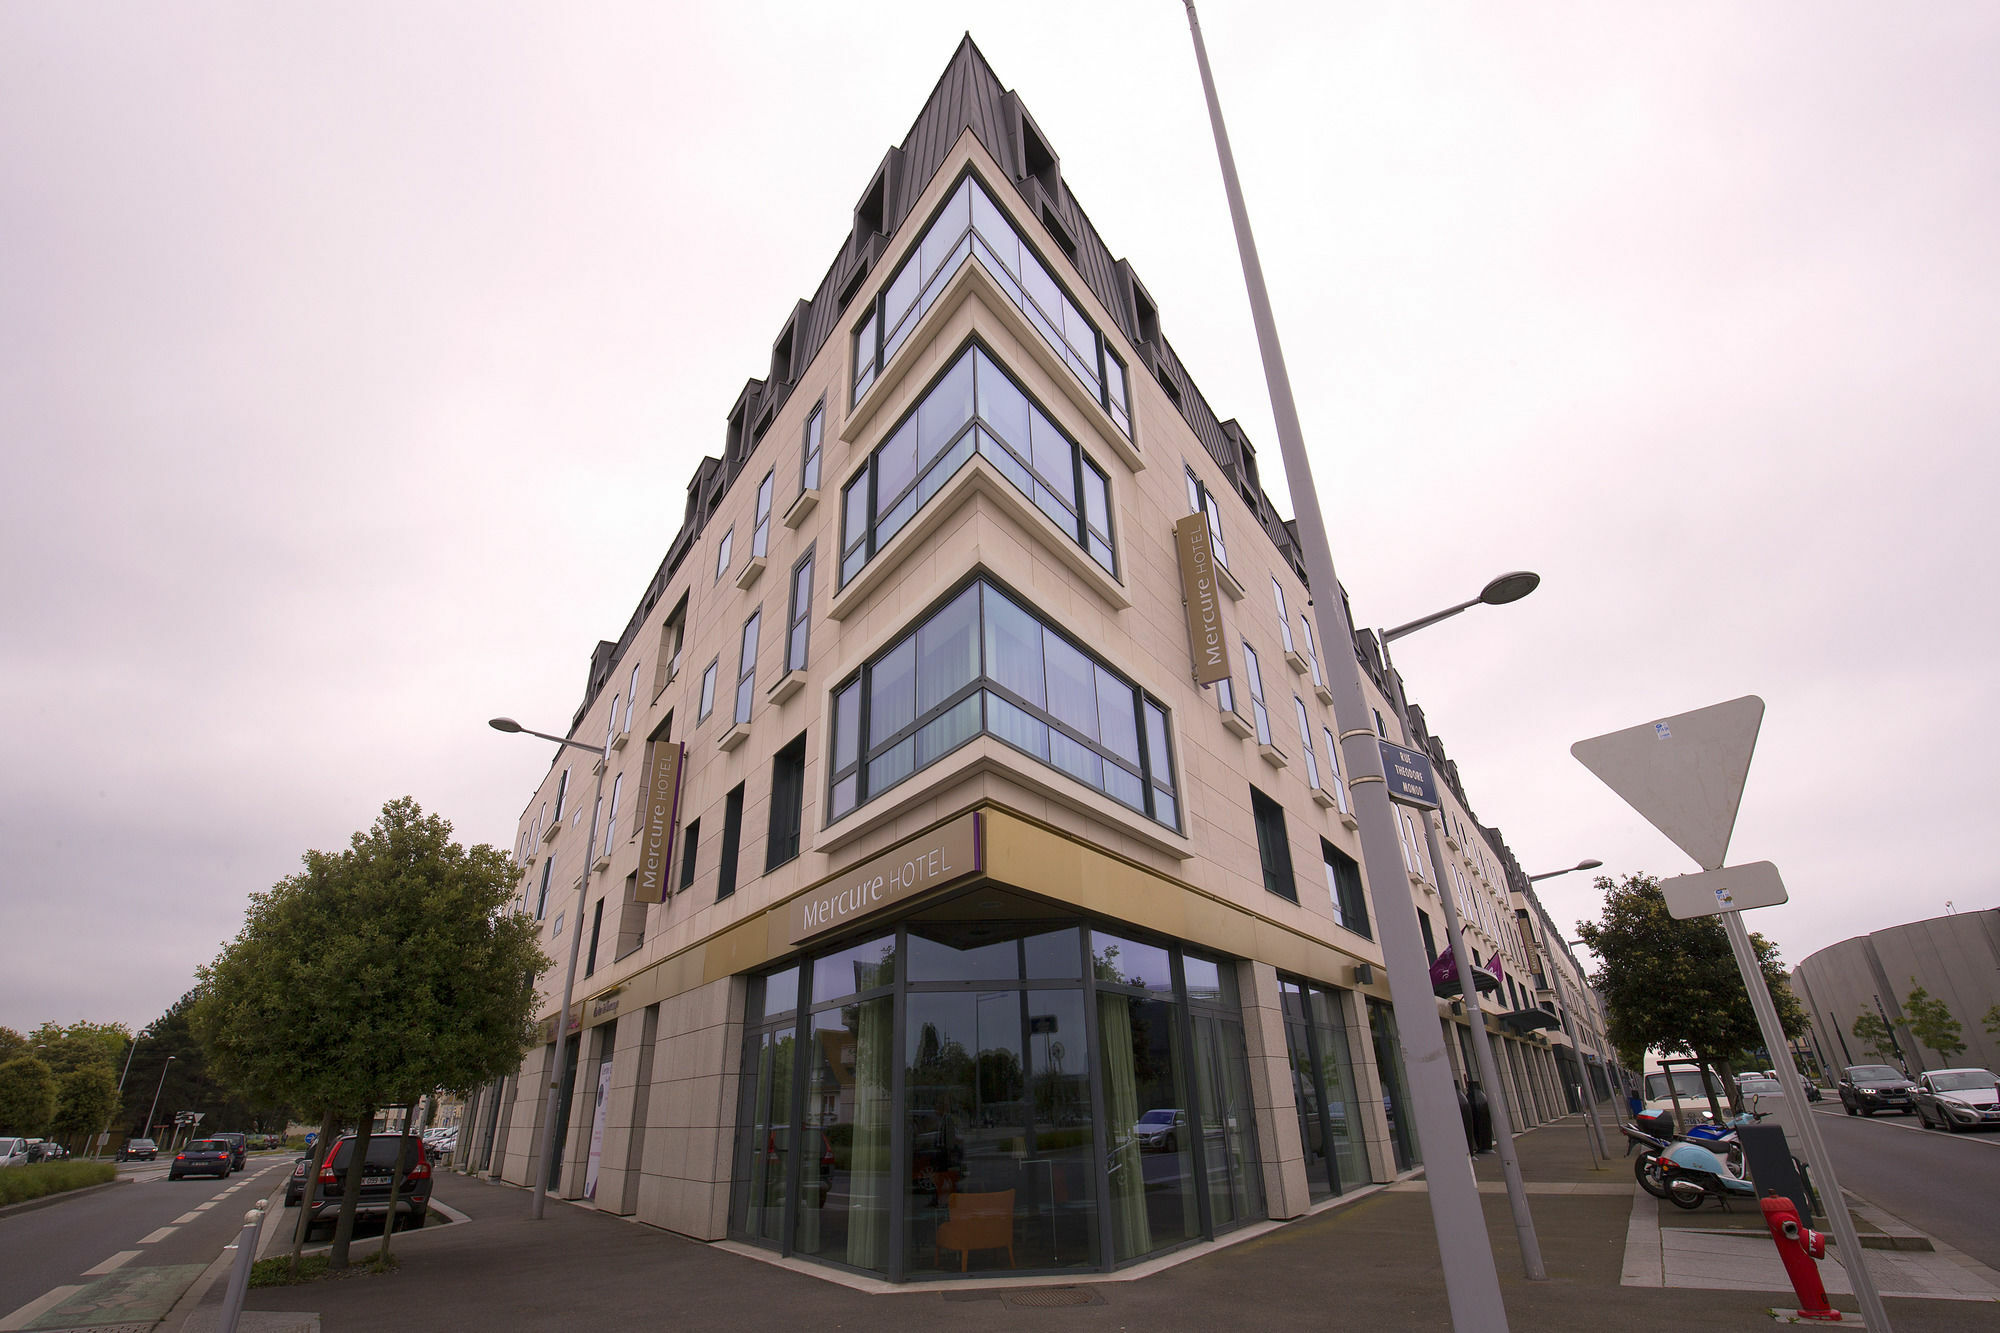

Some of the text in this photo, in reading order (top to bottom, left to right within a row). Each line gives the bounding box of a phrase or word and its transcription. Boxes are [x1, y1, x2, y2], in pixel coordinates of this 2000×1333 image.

[1191, 524, 1222, 666] Mercure HOTEL
[1394, 764, 1424, 782] THEODORE
[1399, 751, 1412, 764] RUE
[1402, 782, 1424, 797] MONOD
[643, 755, 673, 888] Mercure HOTEL
[803, 846, 952, 930] Mercure HOTEL
